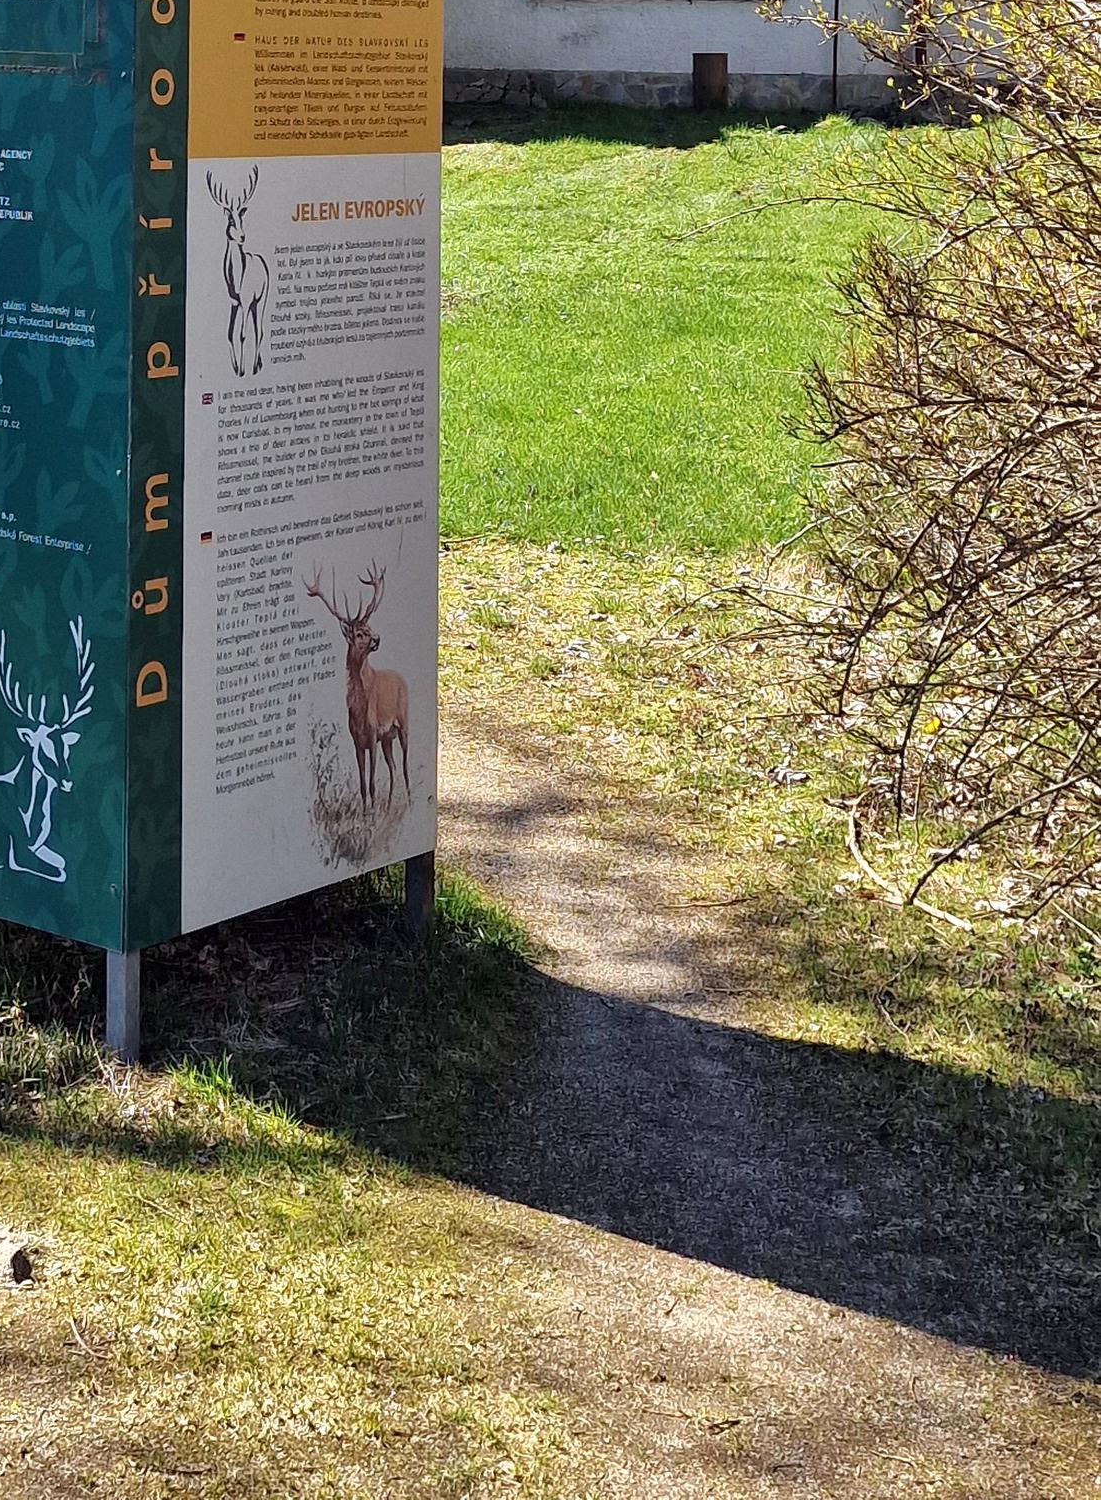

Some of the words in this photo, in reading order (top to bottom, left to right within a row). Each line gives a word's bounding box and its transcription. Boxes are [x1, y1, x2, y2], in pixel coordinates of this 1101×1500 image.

[283, 36, 299, 45] DER
[0, 149, 33, 160] AGENCY
[291, 201, 340, 222] JELEN
[345, 193, 426, 219] EVROPSKÝ
[18, 531, 43, 545] Forest
[132, 471, 170, 708] Dům
